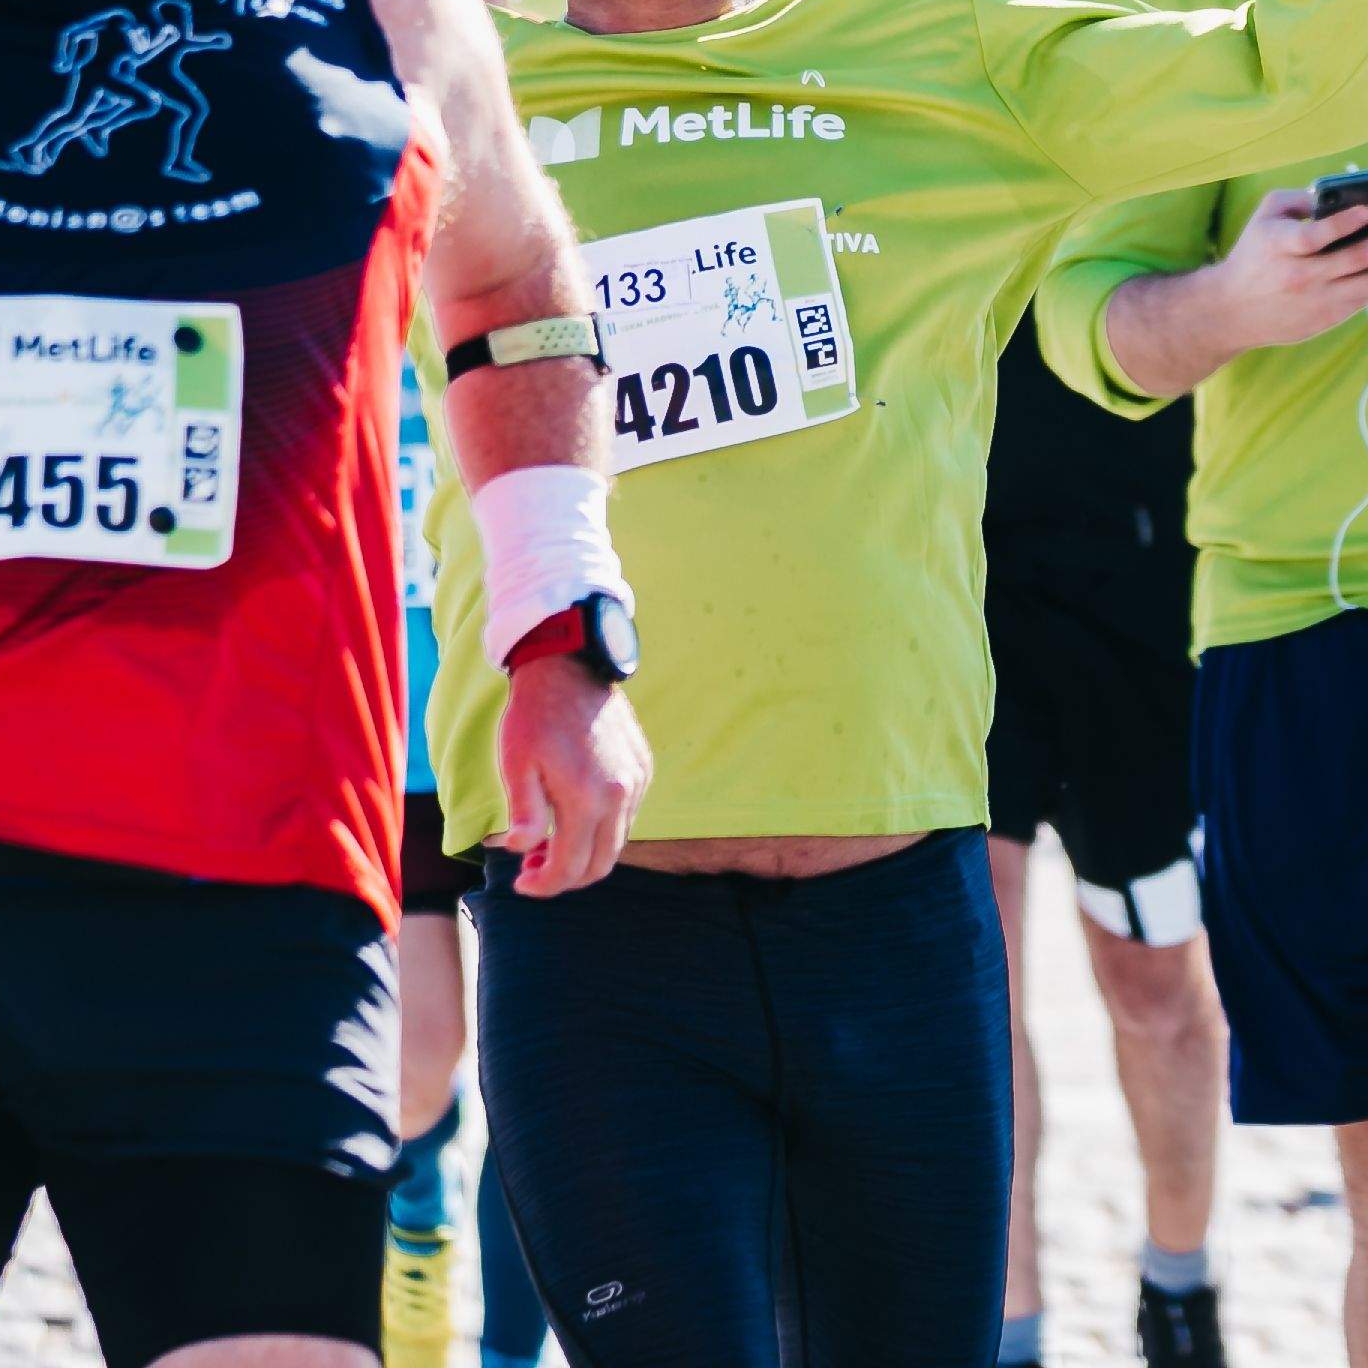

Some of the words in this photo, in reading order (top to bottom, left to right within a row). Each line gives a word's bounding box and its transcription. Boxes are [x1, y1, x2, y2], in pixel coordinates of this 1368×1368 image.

[620, 102, 847, 147] MetLife
[595, 268, 667, 310] 133
[13, 331, 157, 363] MetLife
[614, 345, 779, 445] 4210
